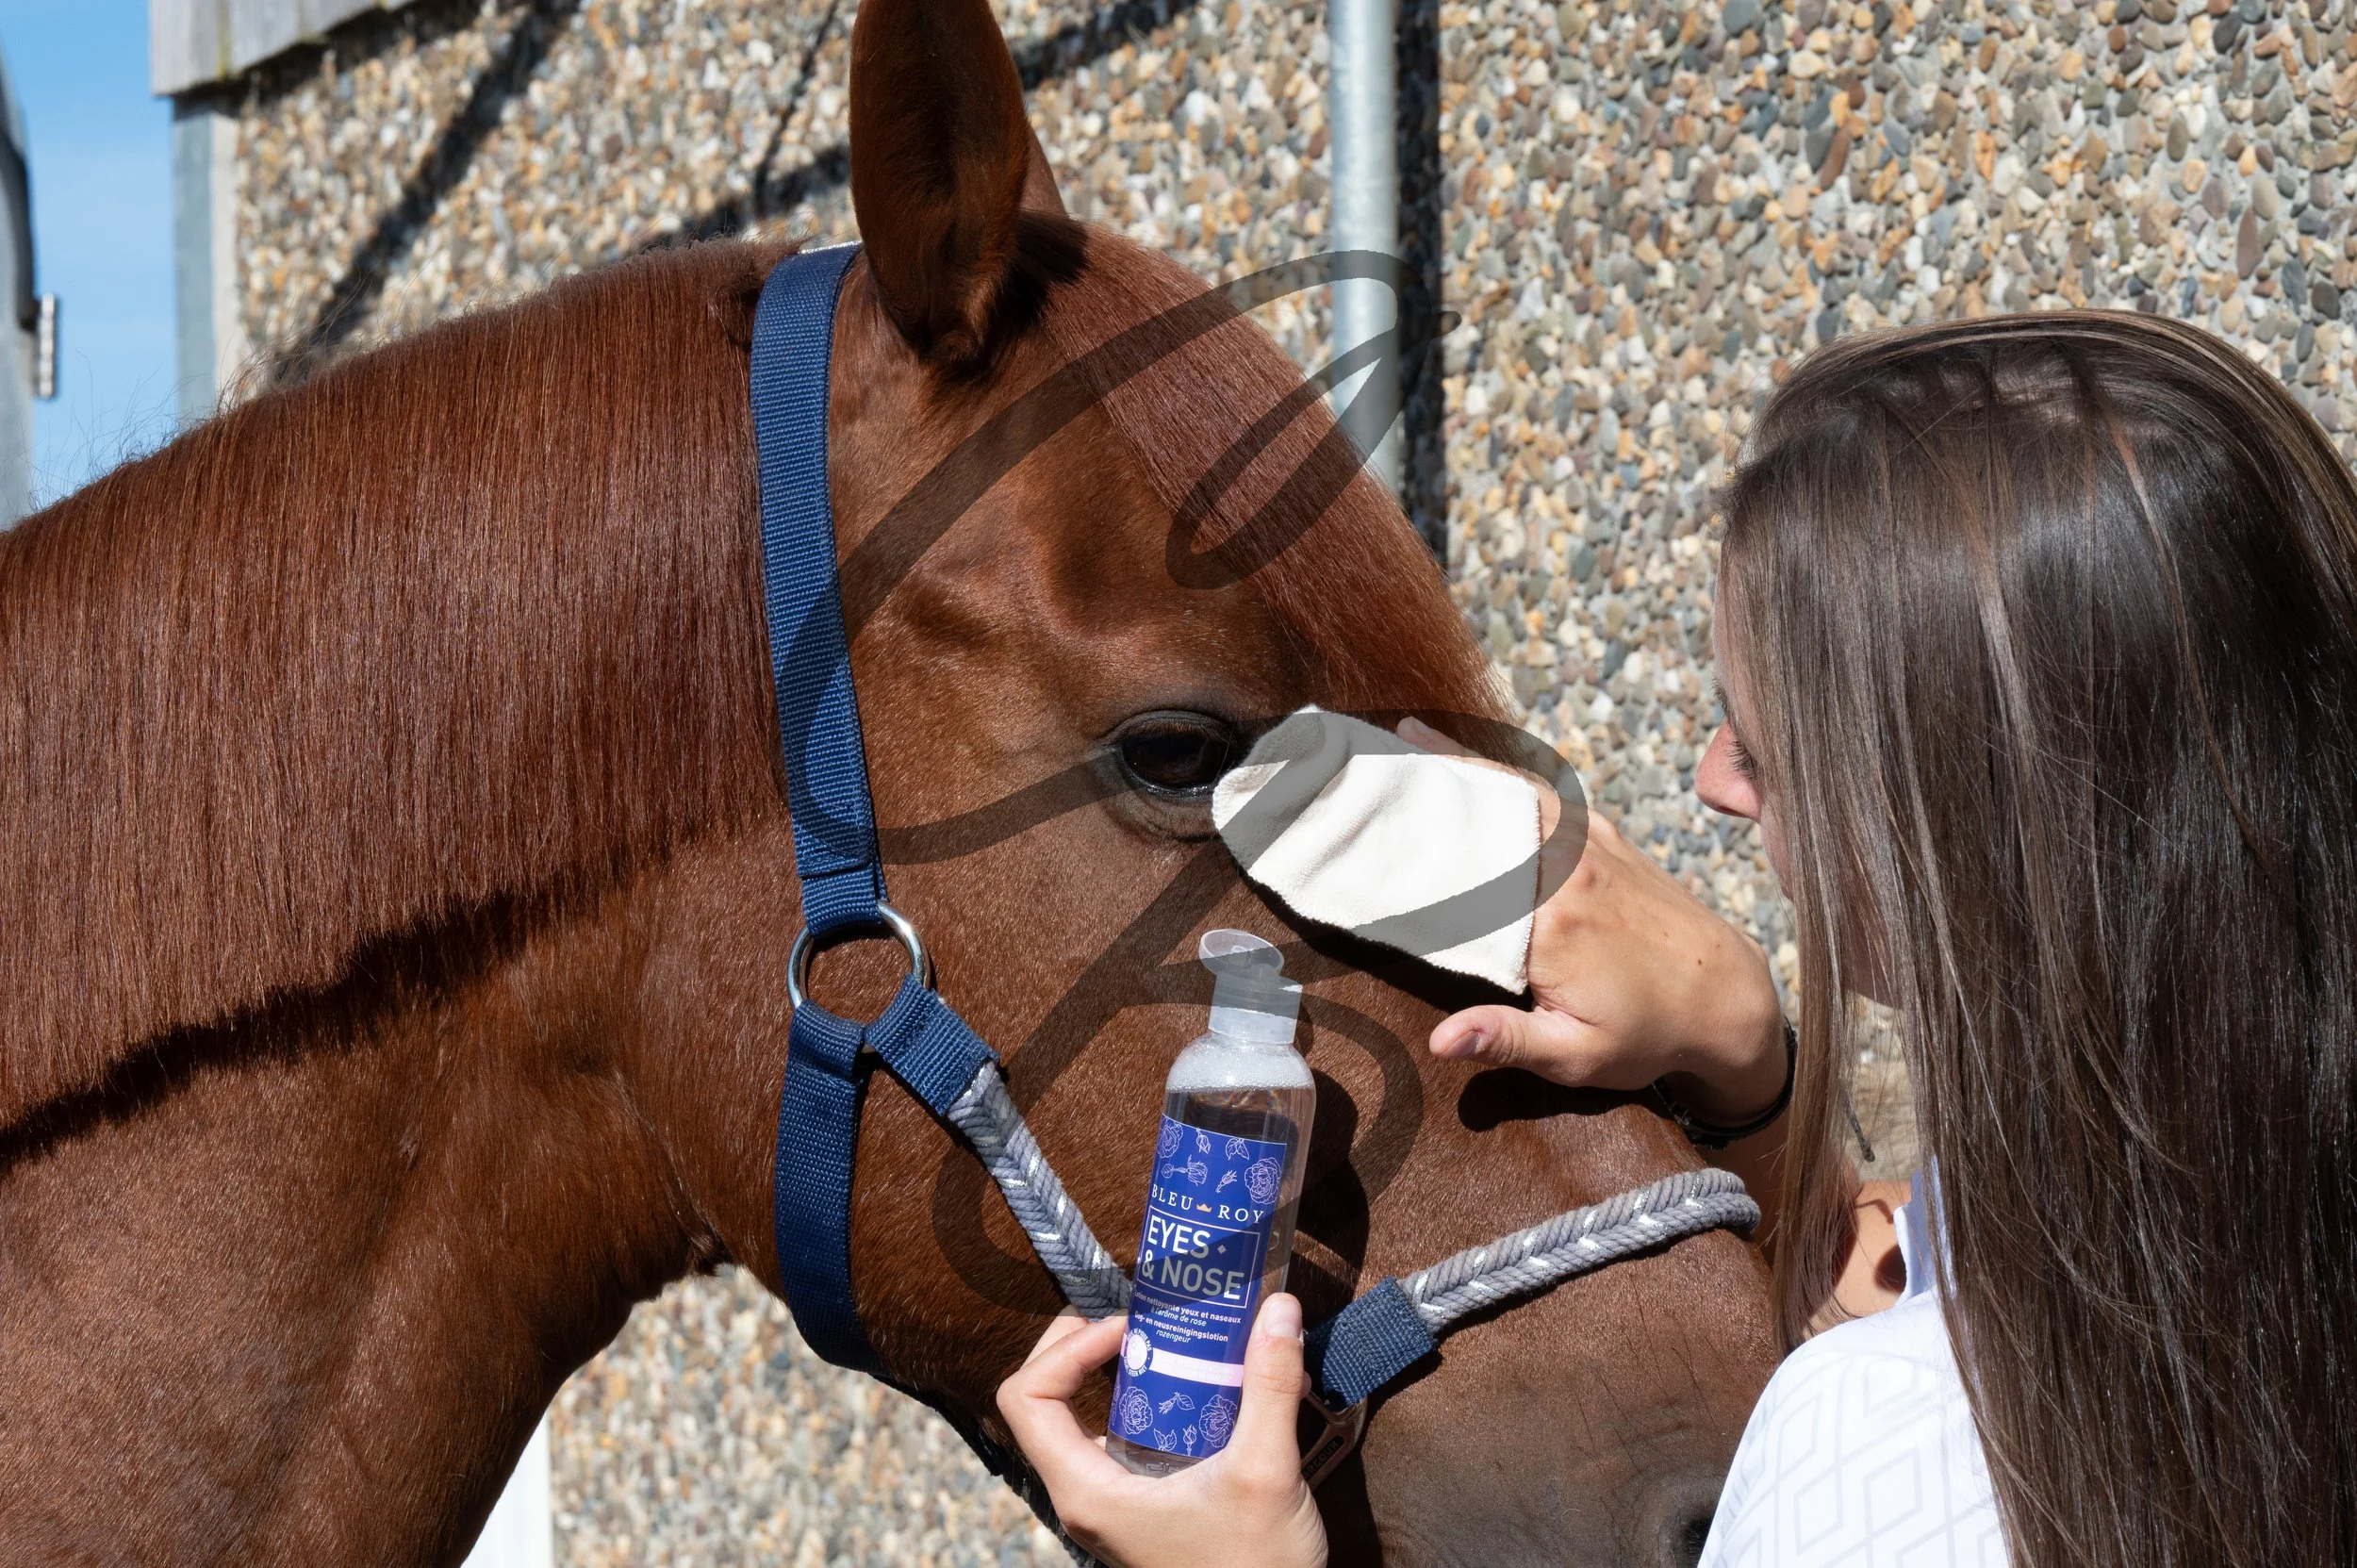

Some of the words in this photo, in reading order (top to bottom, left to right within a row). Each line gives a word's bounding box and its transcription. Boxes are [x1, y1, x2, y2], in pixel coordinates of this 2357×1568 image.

[1151, 1183, 1194, 1211] BLEU
[1217, 1204, 1264, 1224] ROY
[1146, 1214, 1211, 1259] EYES
[1141, 1249, 1155, 1280] &
[1161, 1255, 1244, 1300] NOSE
[1146, 1296, 1180, 1312] nettoyante
[1180, 1307, 1199, 1317] yeux
[1210, 1313, 1242, 1324] naseaux
[1179, 1314, 1189, 1323] de
[1189, 1318, 1207, 1327] rose
[1153, 1320, 1228, 1343] neusreinigingslotion
[1155, 1329, 1192, 1344] rozengeur
[1302, 1440, 1341, 1480] ARCOUR
